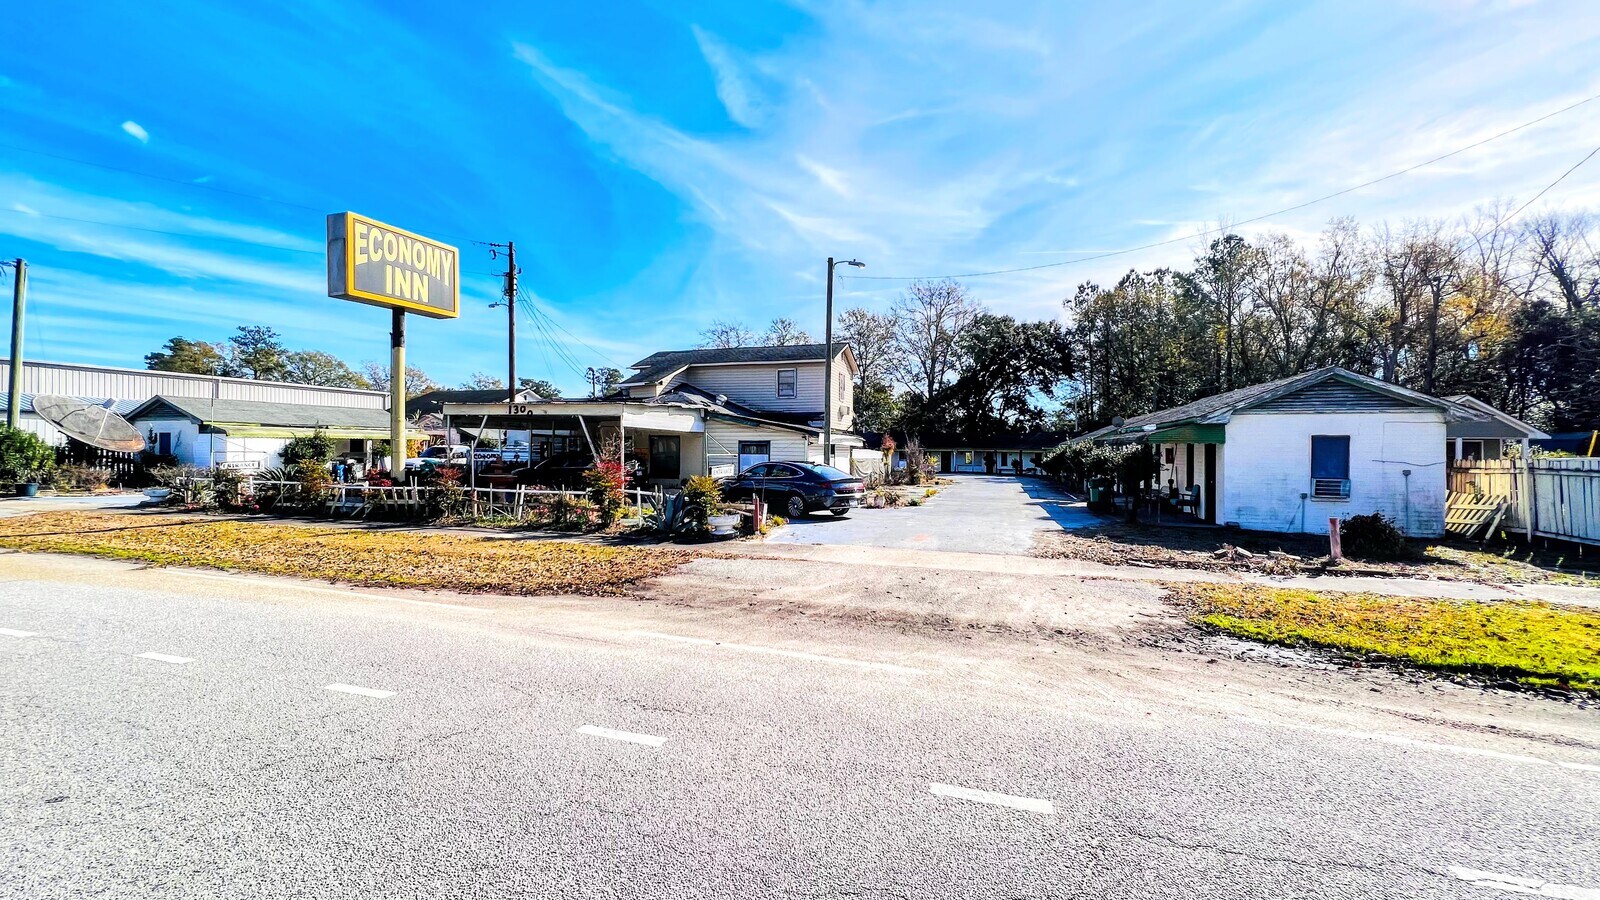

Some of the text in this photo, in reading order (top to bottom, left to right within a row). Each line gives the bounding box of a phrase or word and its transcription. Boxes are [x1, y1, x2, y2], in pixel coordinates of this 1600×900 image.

[354, 222, 453, 287] ECONOMY
[386, 264, 429, 303] INN
[509, 404, 533, 417] 1300
